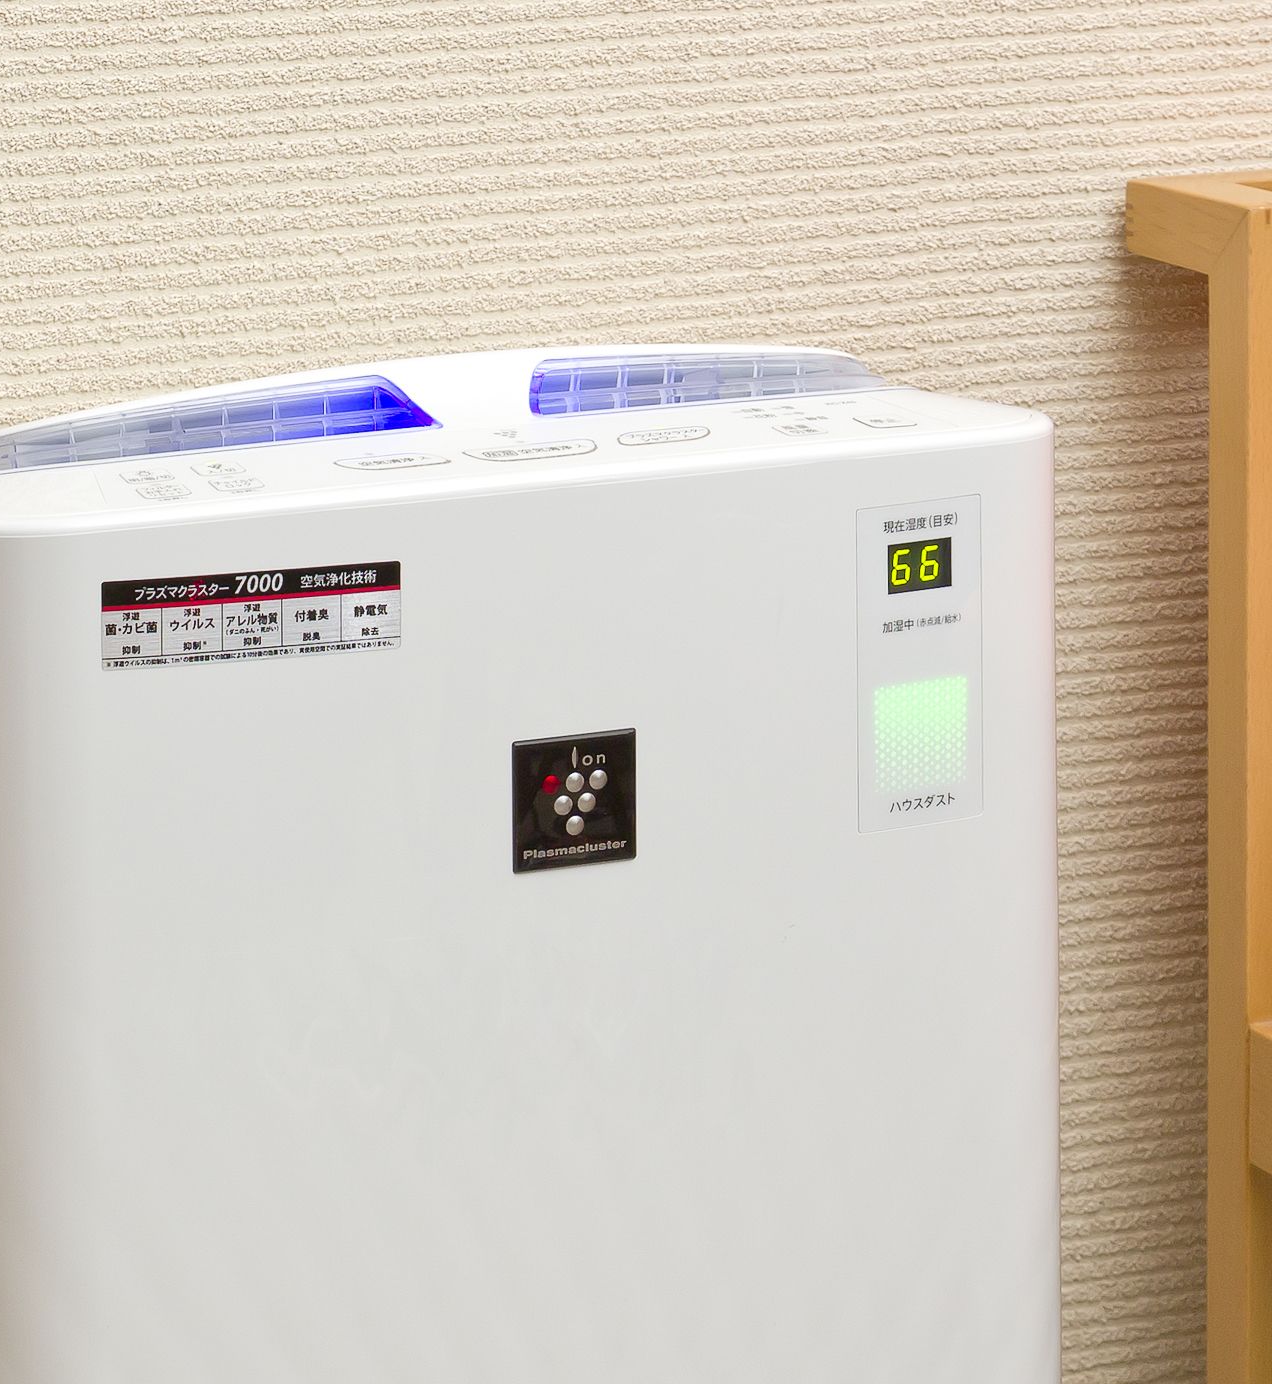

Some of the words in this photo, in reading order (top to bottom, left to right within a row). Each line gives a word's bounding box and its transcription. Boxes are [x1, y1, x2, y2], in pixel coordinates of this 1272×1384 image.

[891, 544, 939, 586] 66
[134, 585, 230, 602] プラズマクラスター
[234, 572, 284, 595] 7000
[300, 569, 377, 589] 空気浄化技術
[226, 612, 278, 628] アレル物質
[294, 608, 330, 623] 付着臭
[353, 603, 388, 618] 静電気
[169, 617, 216, 632] ウイルス
[571, 746, 606, 769] Ion
[889, 792, 956, 814] ハウスダスト
[523, 839, 628, 860] Plasmacluster
